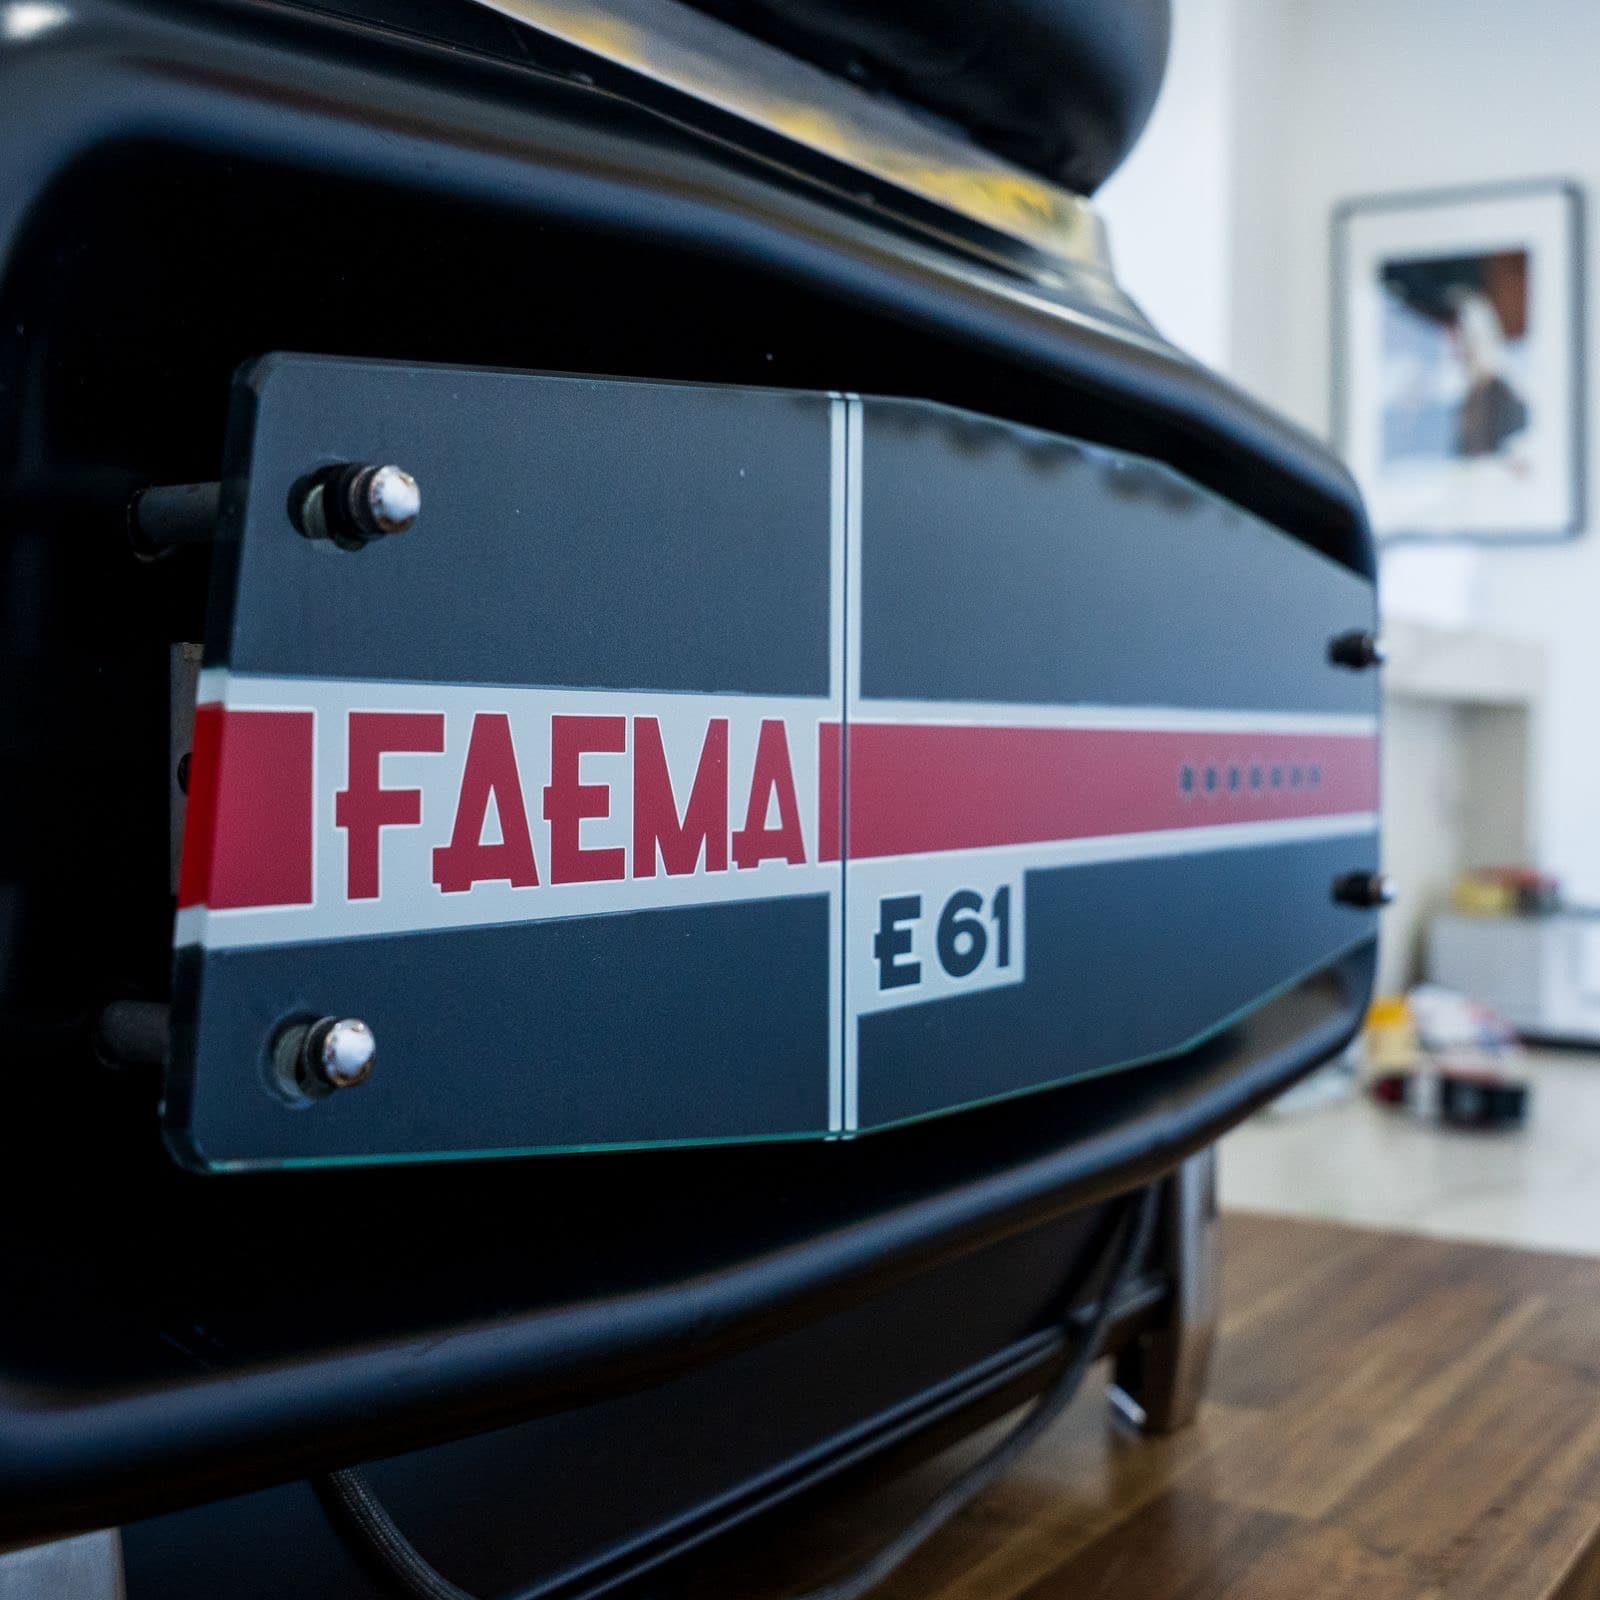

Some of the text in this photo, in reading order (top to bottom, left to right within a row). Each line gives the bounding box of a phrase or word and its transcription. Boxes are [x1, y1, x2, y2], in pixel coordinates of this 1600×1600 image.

[335, 710, 808, 900] FAEMA
[873, 883, 1011, 991] E 61
